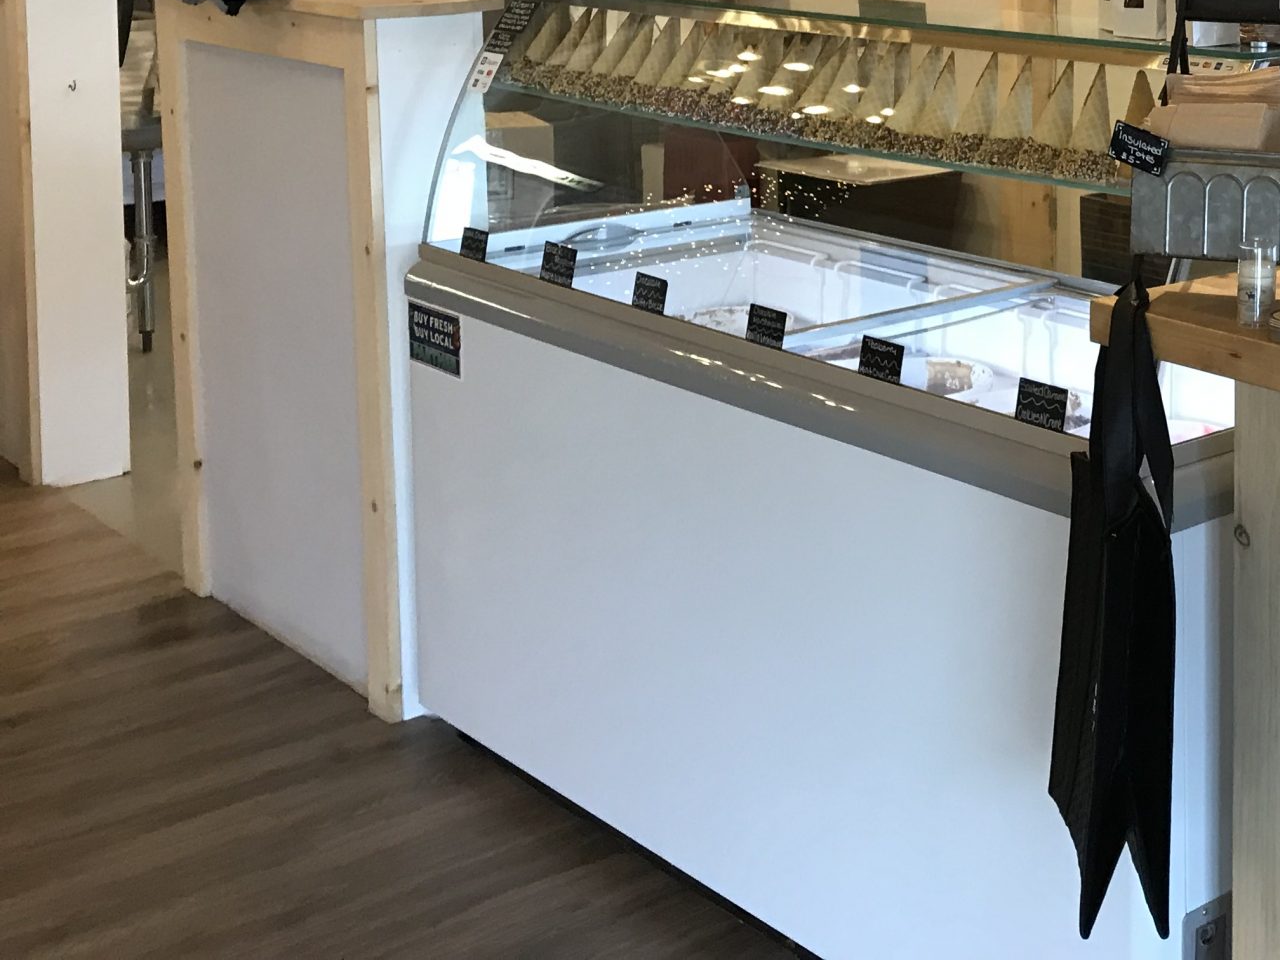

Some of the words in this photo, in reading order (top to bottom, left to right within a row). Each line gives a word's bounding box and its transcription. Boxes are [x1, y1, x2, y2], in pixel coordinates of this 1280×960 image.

[1118, 126, 1163, 157] Insulated
[1127, 145, 1155, 164] Totes
[413, 311, 429, 326] BUY
[429, 316, 453, 335] FRESH
[413, 323, 429, 340] BUY
[430, 330, 454, 349] LOCAL
